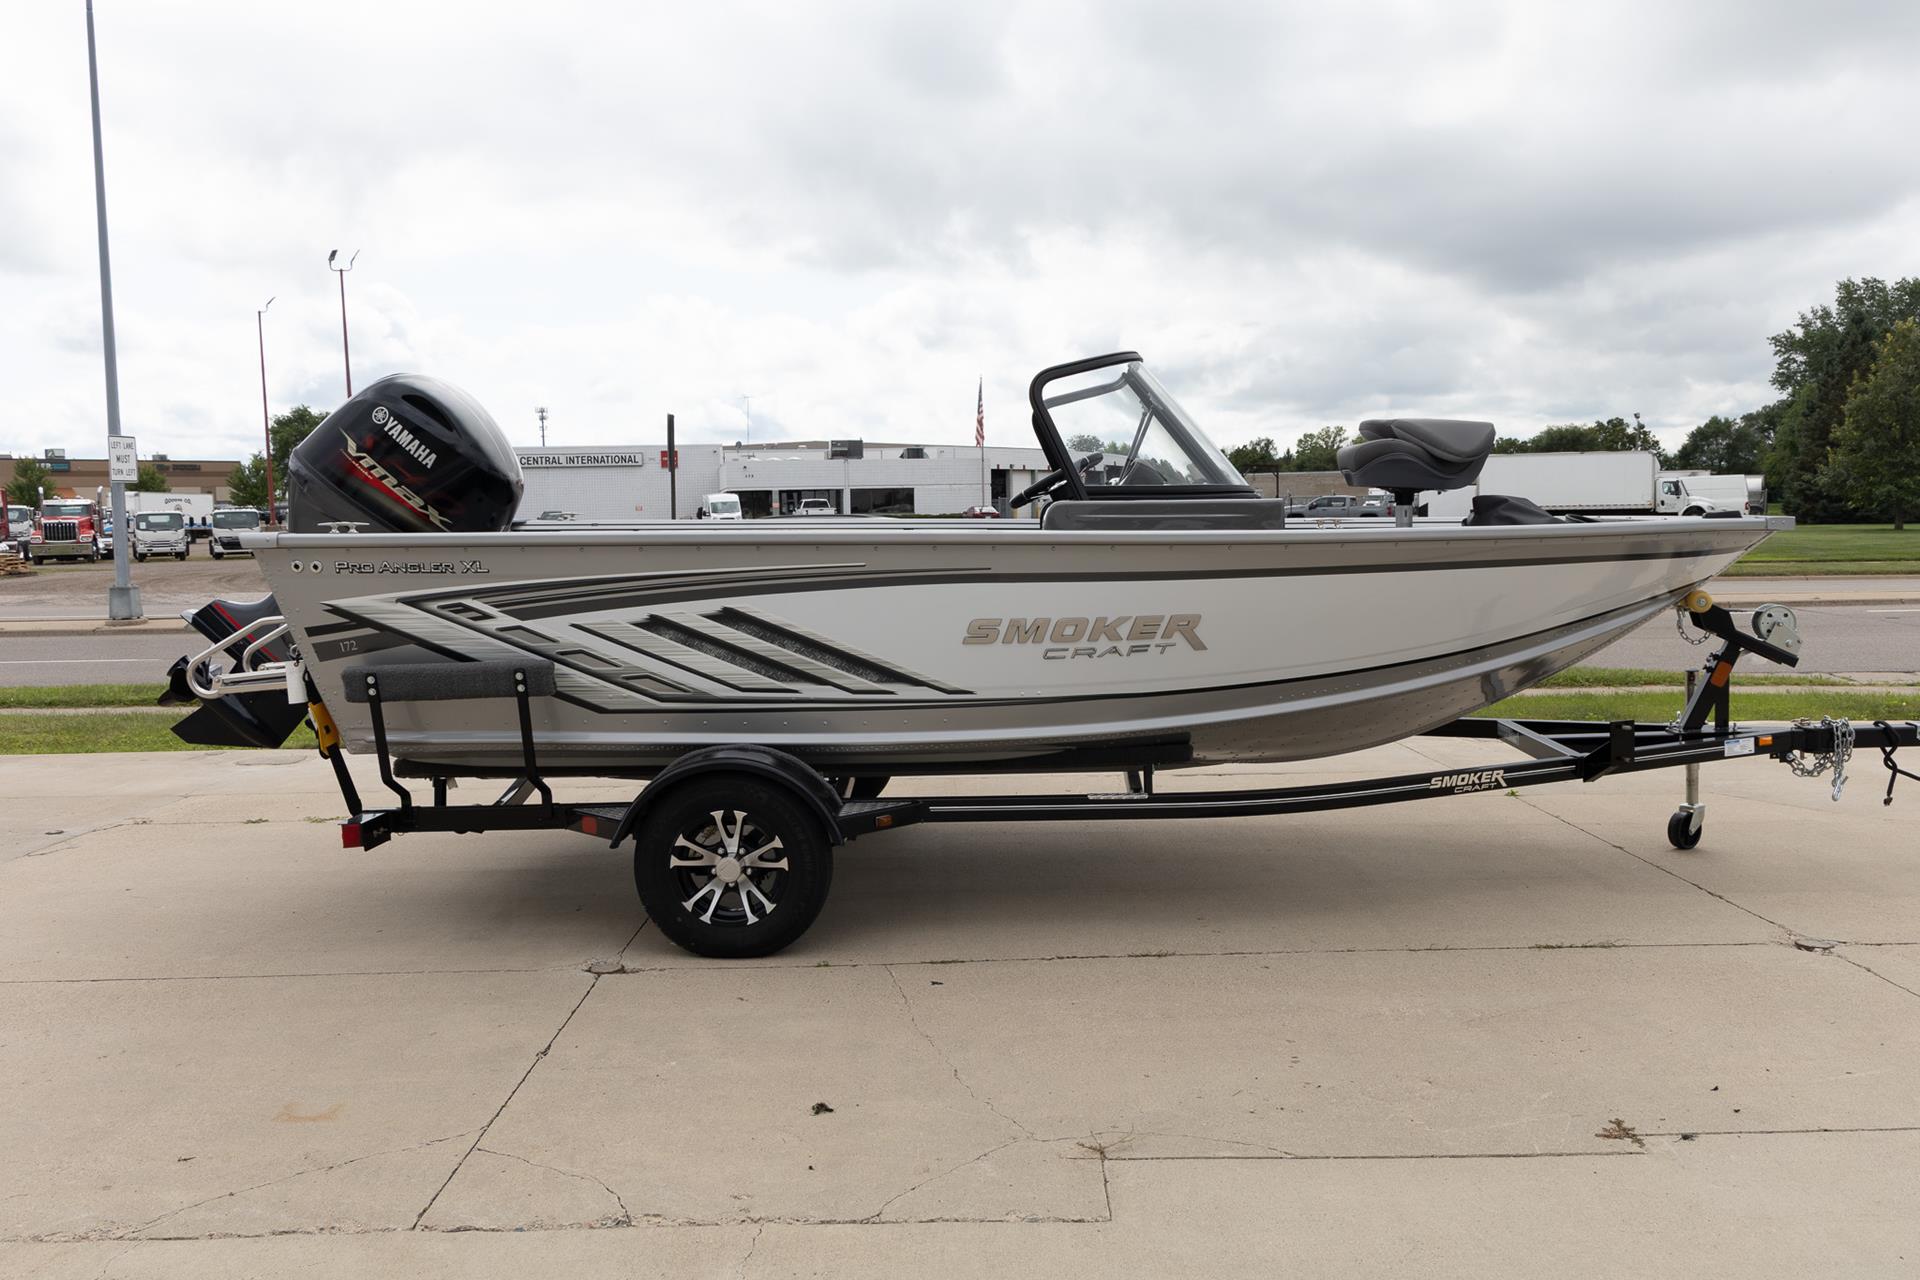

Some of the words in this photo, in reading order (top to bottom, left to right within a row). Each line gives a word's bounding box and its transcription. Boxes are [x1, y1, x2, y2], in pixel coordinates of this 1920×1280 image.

[111, 441, 122, 449] LEFT
[123, 442, 135, 450] LANE
[383, 416, 438, 469] YAMAHA
[115, 454, 131, 463] MUST
[519, 455, 563, 466] CENTRAL
[565, 454, 639, 465] INTERNATIONAL
[112, 468, 124, 476] TURN
[125, 468, 136, 477] LEFT
[459, 560, 490, 574] XL
[962, 613, 1208, 651] SMOKER
[339, 640, 359, 653] 172
[1042, 642, 1177, 661] CRAFT
[1429, 769, 1507, 790] SMOKER
[1454, 782, 1498, 794] CRAFT
